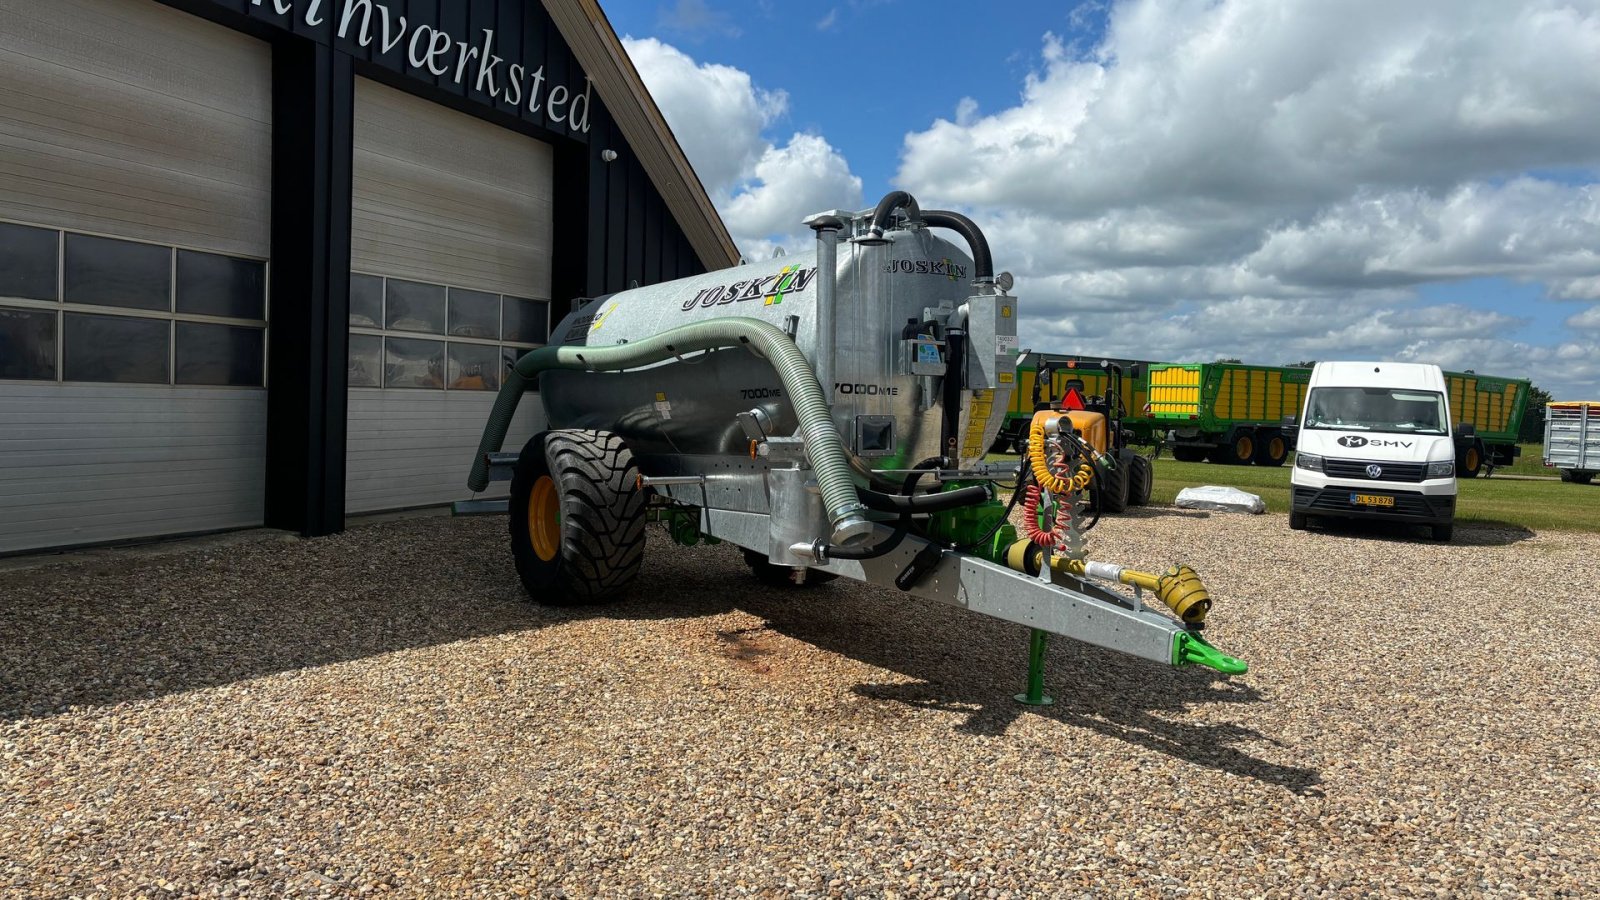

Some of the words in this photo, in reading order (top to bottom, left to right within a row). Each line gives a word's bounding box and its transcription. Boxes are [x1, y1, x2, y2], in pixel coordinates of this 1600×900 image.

[881, 258, 967, 279] JOSKIN
[681, 266, 818, 312] JOSKIN
[1370, 439, 1413, 448] SMV
